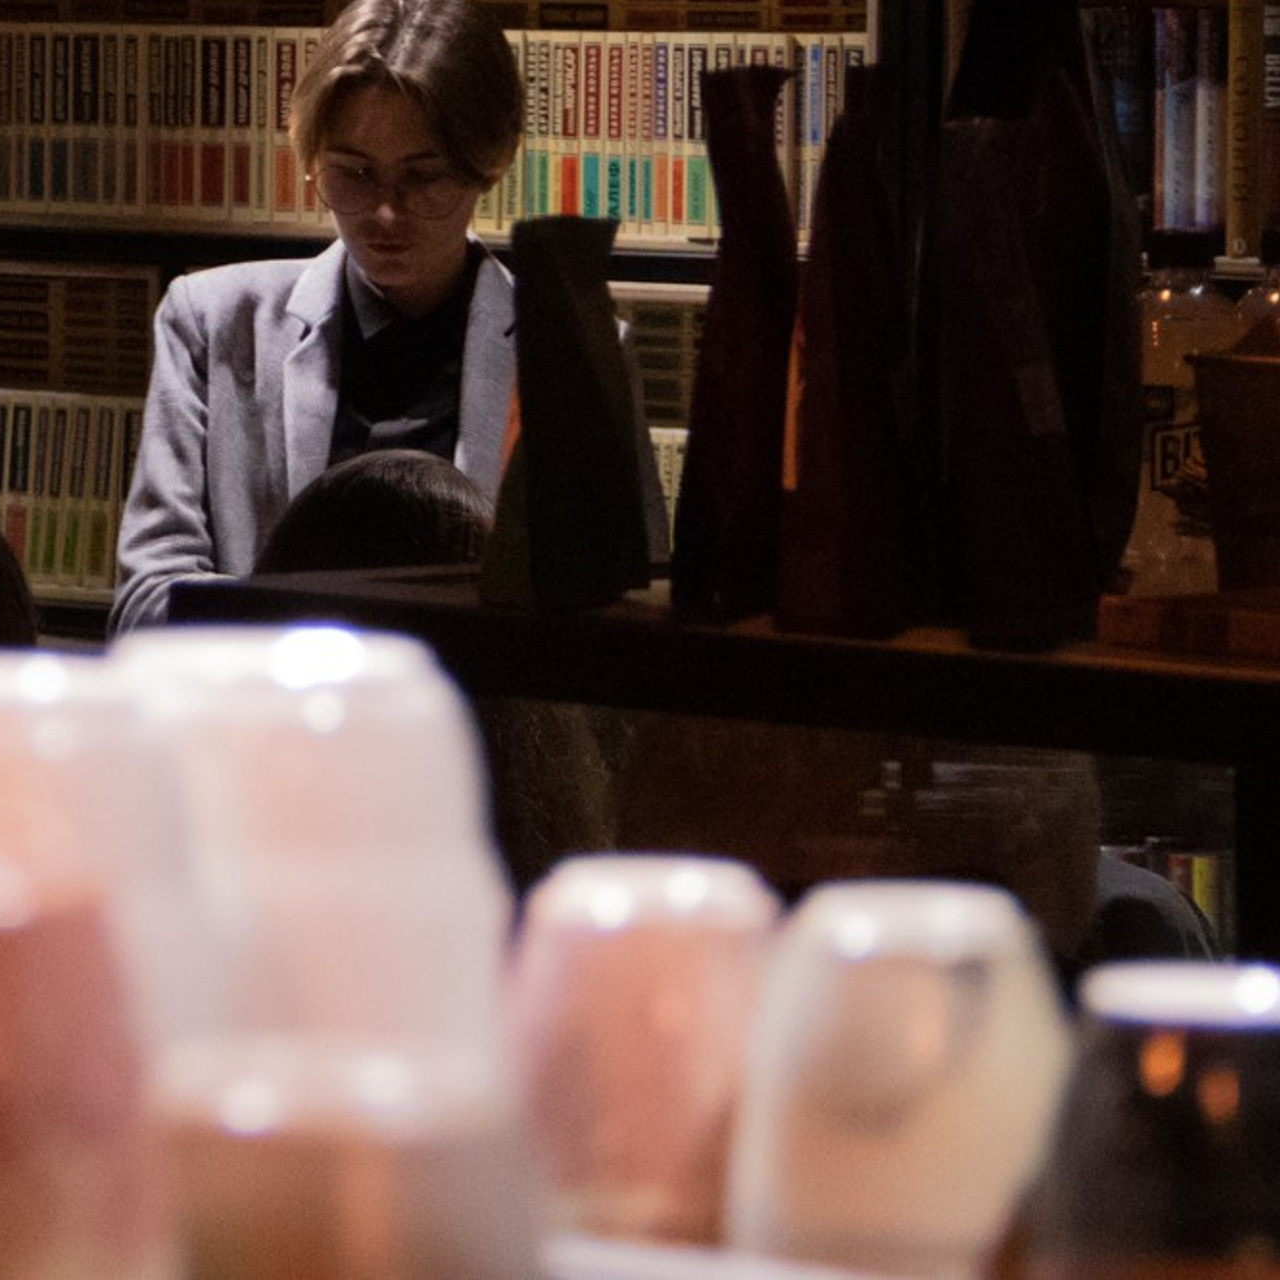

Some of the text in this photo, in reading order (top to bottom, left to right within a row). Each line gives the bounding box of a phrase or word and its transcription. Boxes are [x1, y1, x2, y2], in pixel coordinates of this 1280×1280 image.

[279, 43, 292, 80] ЗОЛЯ
[564, 48, 576, 109] КОРТАСАР
[587, 48, 598, 135] ПАУЛО КОЭЛЬО
[609, 48, 620, 135] ПАУЛО КОЭЛЬО
[608, 161, 620, 217] АЛЕФ
